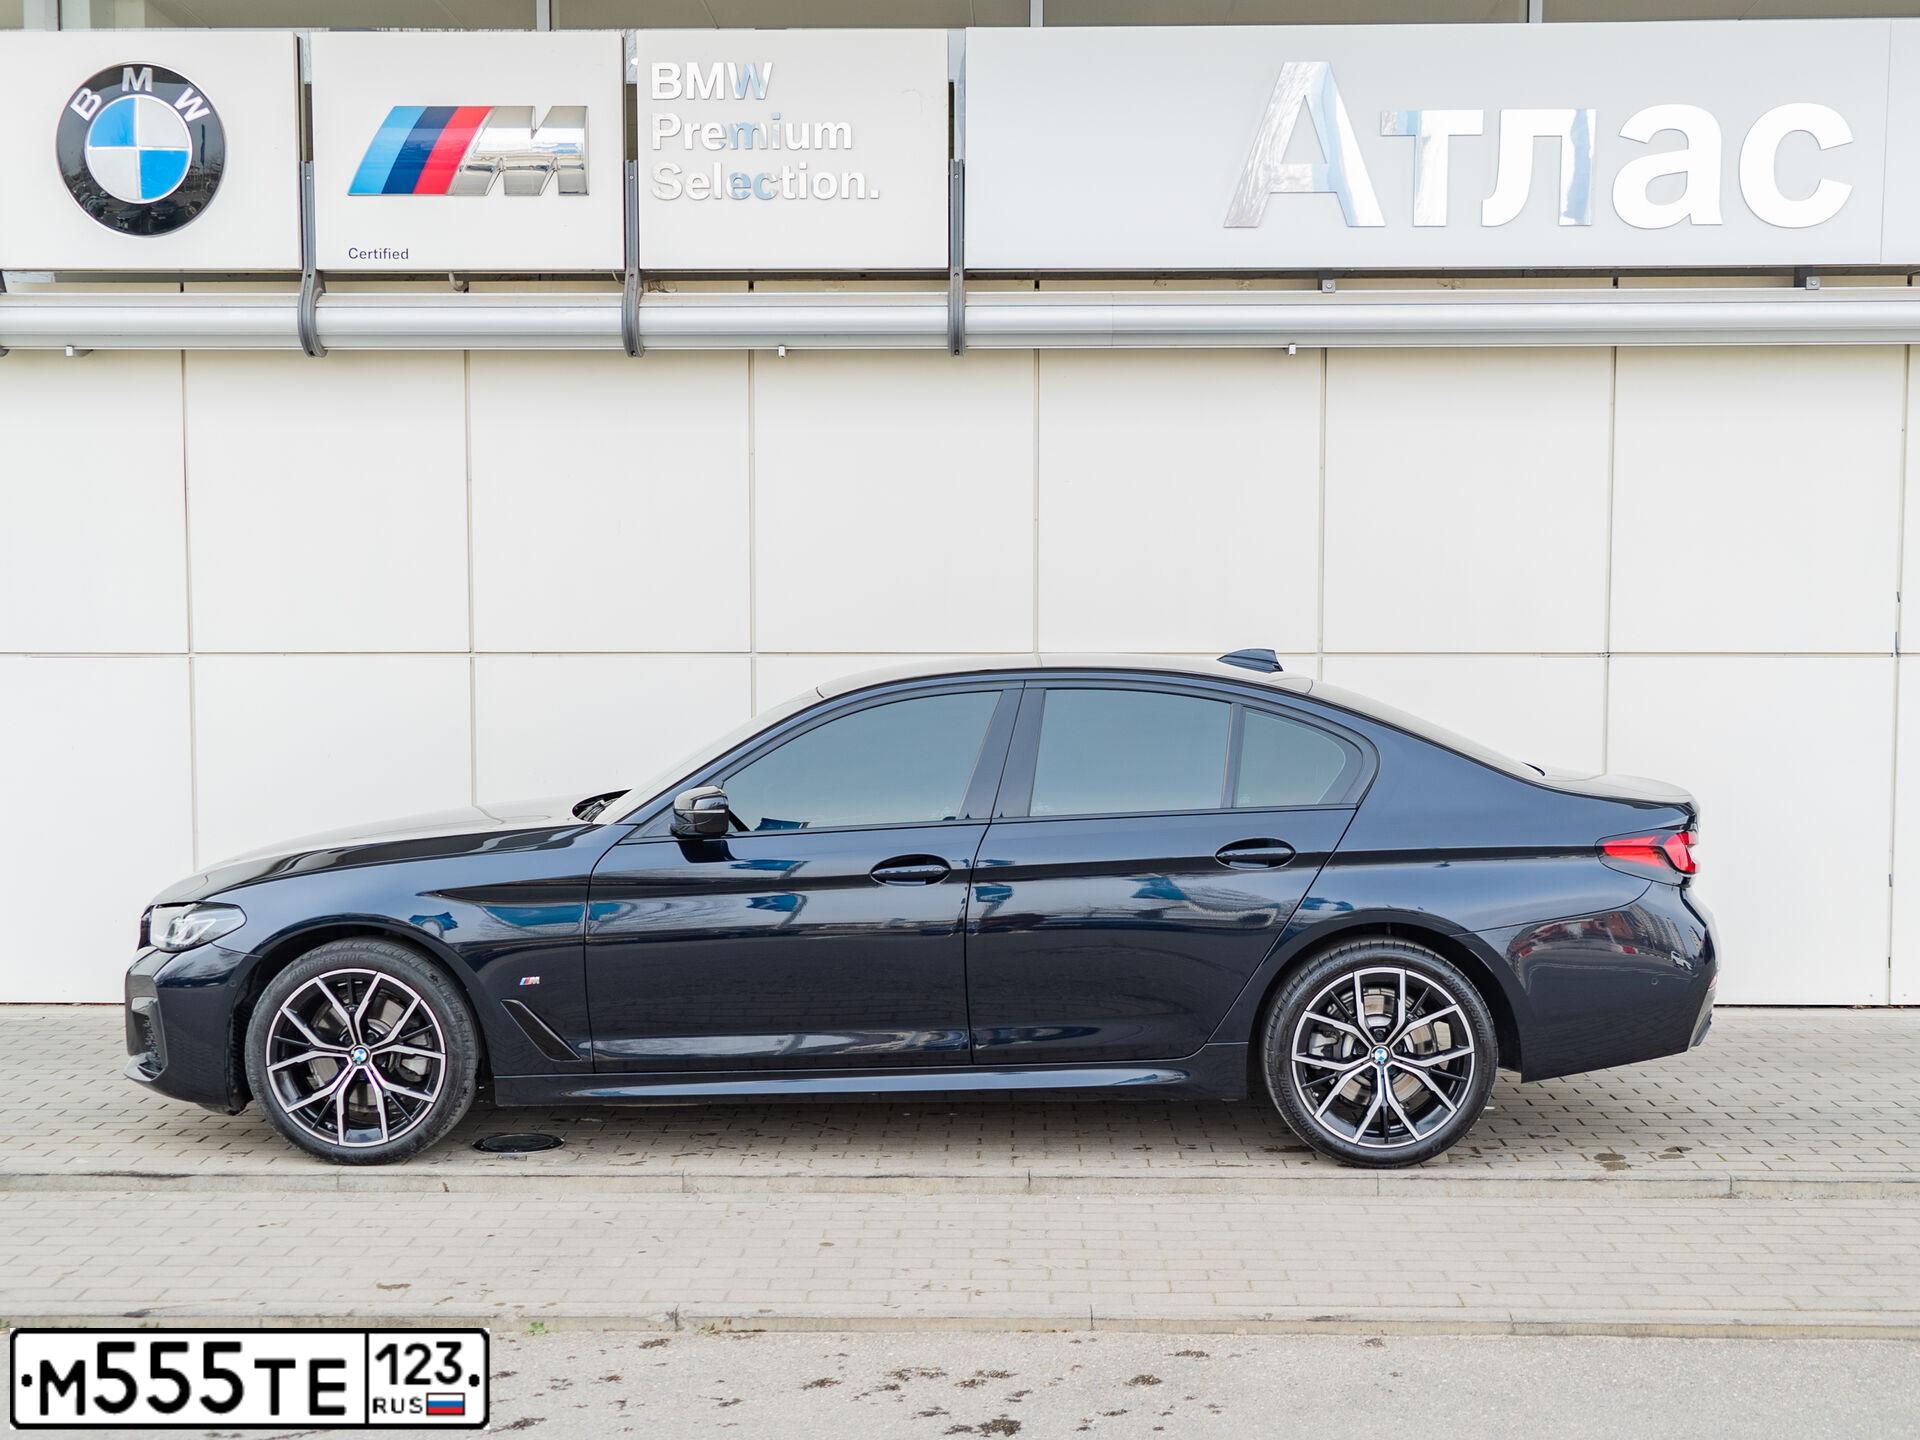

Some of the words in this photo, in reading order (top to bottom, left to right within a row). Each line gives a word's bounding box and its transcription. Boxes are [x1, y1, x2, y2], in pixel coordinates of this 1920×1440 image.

[70, 66, 211, 122] BMW
[651, 61, 774, 101] BMW
[651, 112, 853, 150] Premium
[1223, 61, 1854, 230] Атлас
[651, 161, 880, 200] Selection.
[348, 247, 409, 260] Certified
